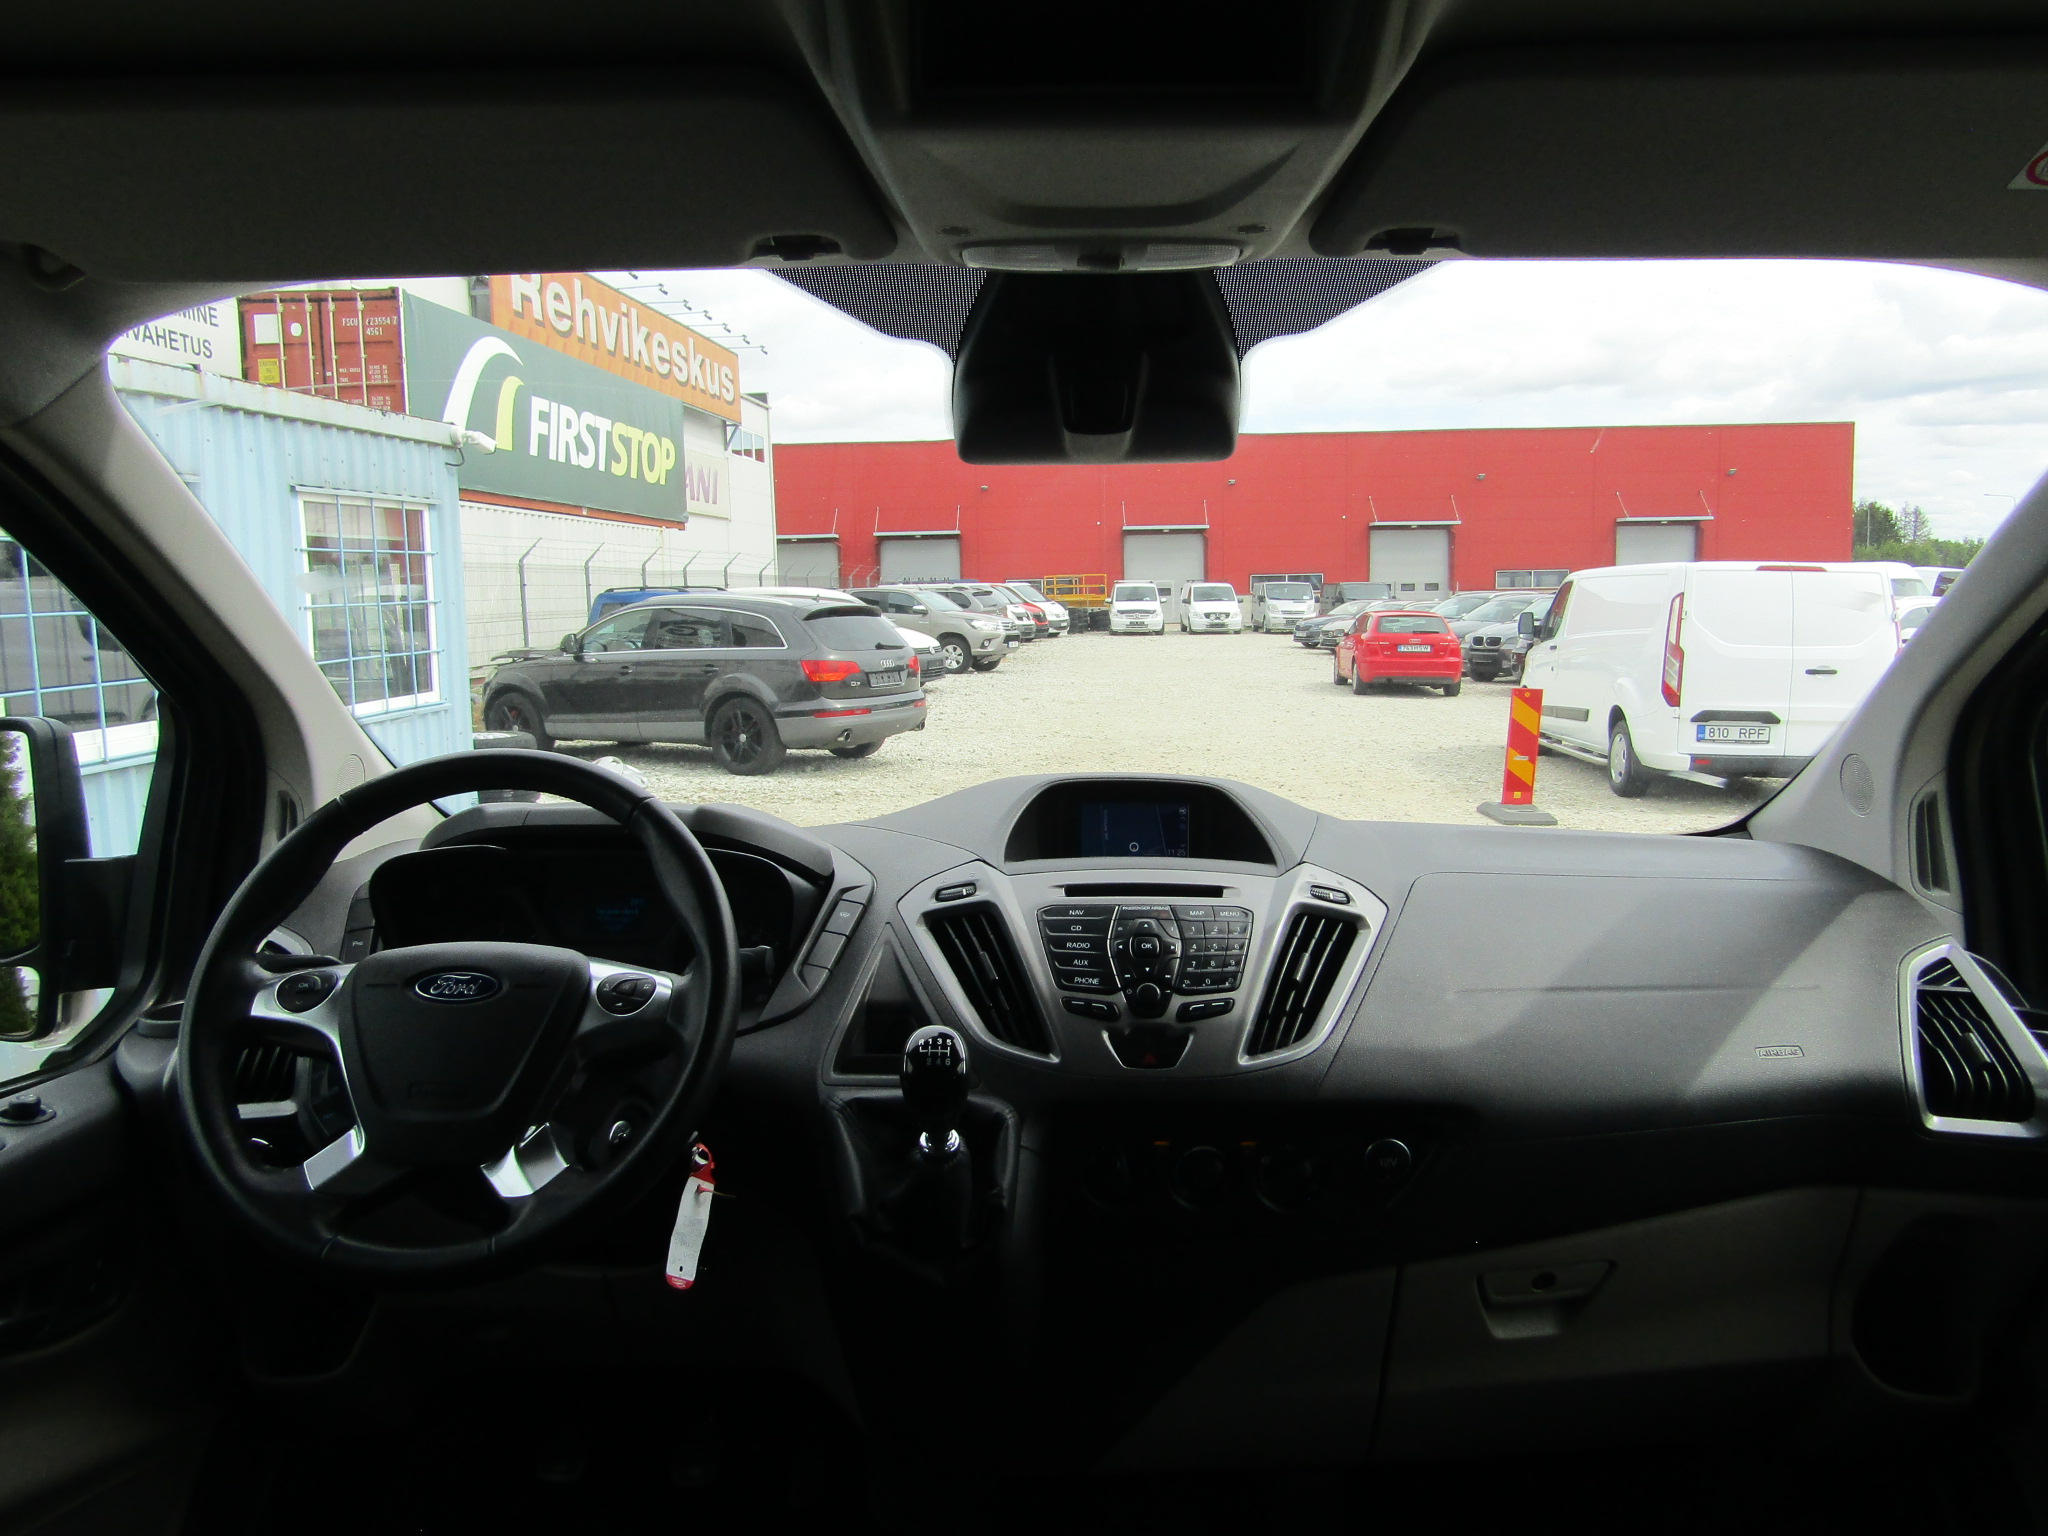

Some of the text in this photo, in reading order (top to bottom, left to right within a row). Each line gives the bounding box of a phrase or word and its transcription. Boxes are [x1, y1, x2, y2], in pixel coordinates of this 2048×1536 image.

[511, 273, 736, 403] Rehvikeskus
[1708, 727, 1729, 738] 810
[1738, 728, 1766, 739] RPF
[1066, 941, 1091, 949] RADIO
[429, 974, 482, 995] Ford
[1074, 976, 1100, 985] PHONE
[1759, 1048, 1800, 1057] AIRBAG
